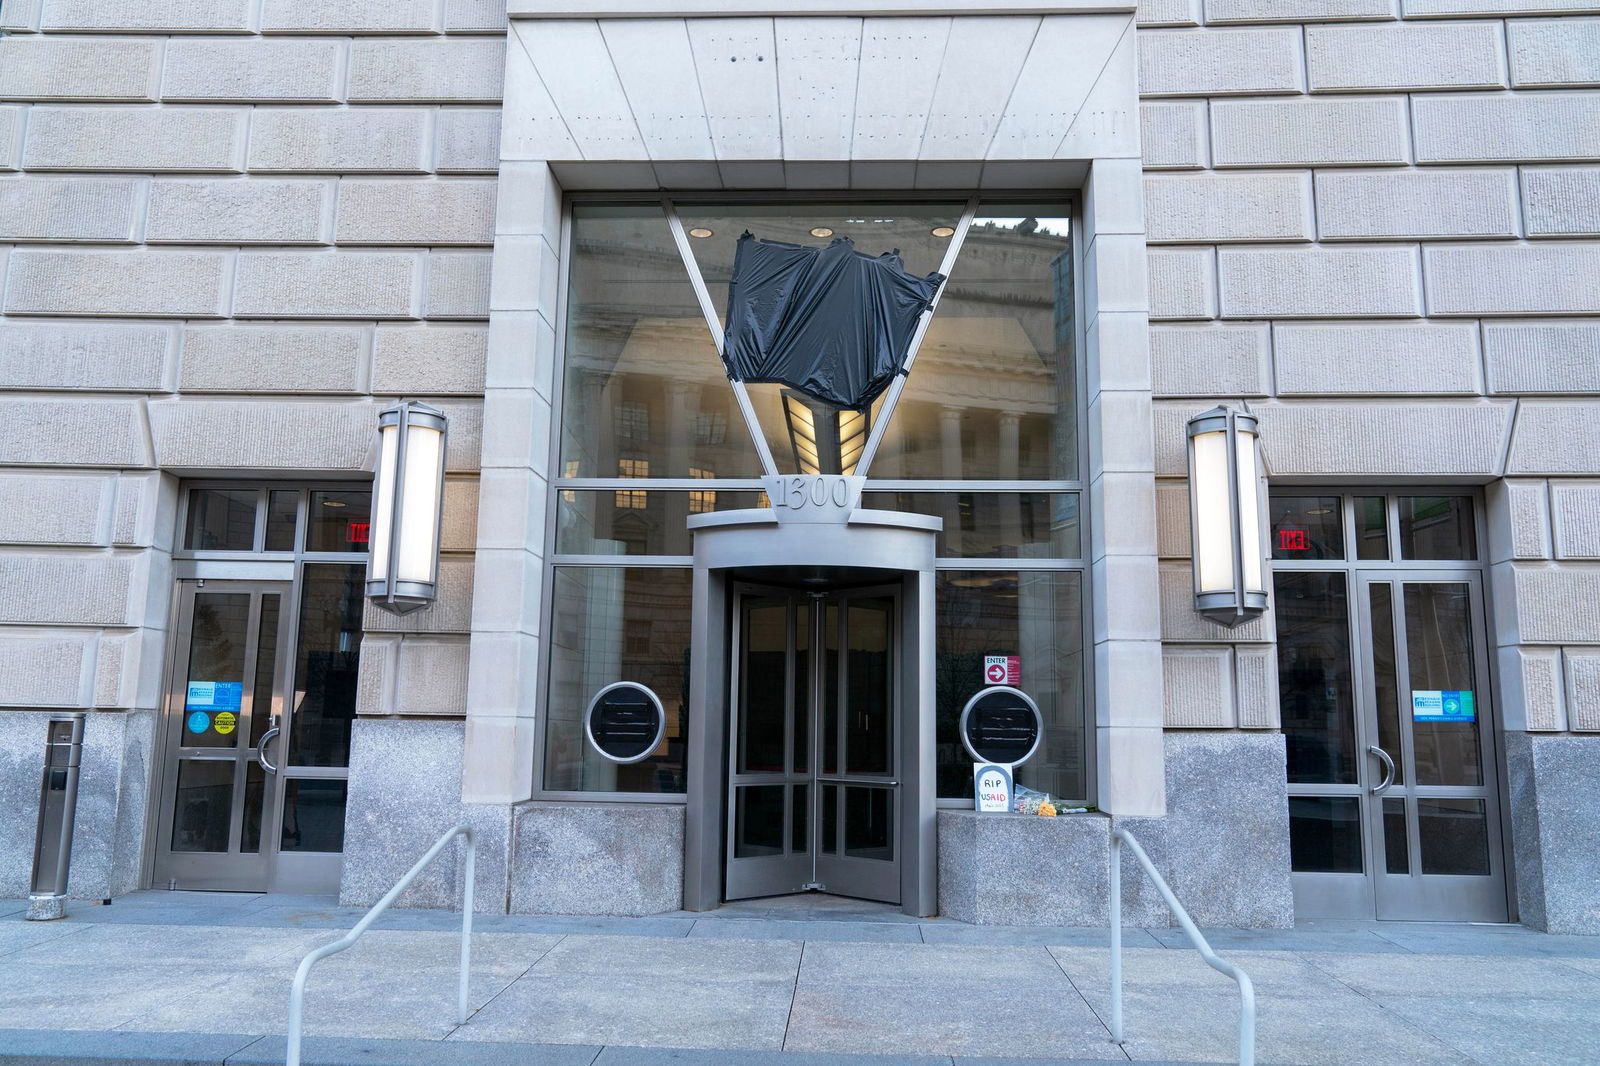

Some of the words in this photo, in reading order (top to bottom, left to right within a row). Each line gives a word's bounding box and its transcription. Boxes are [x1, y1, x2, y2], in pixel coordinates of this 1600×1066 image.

[776, 477, 850, 510] 1300
[984, 779, 1002, 788] RIP
[981, 793, 1006, 802] USAID
